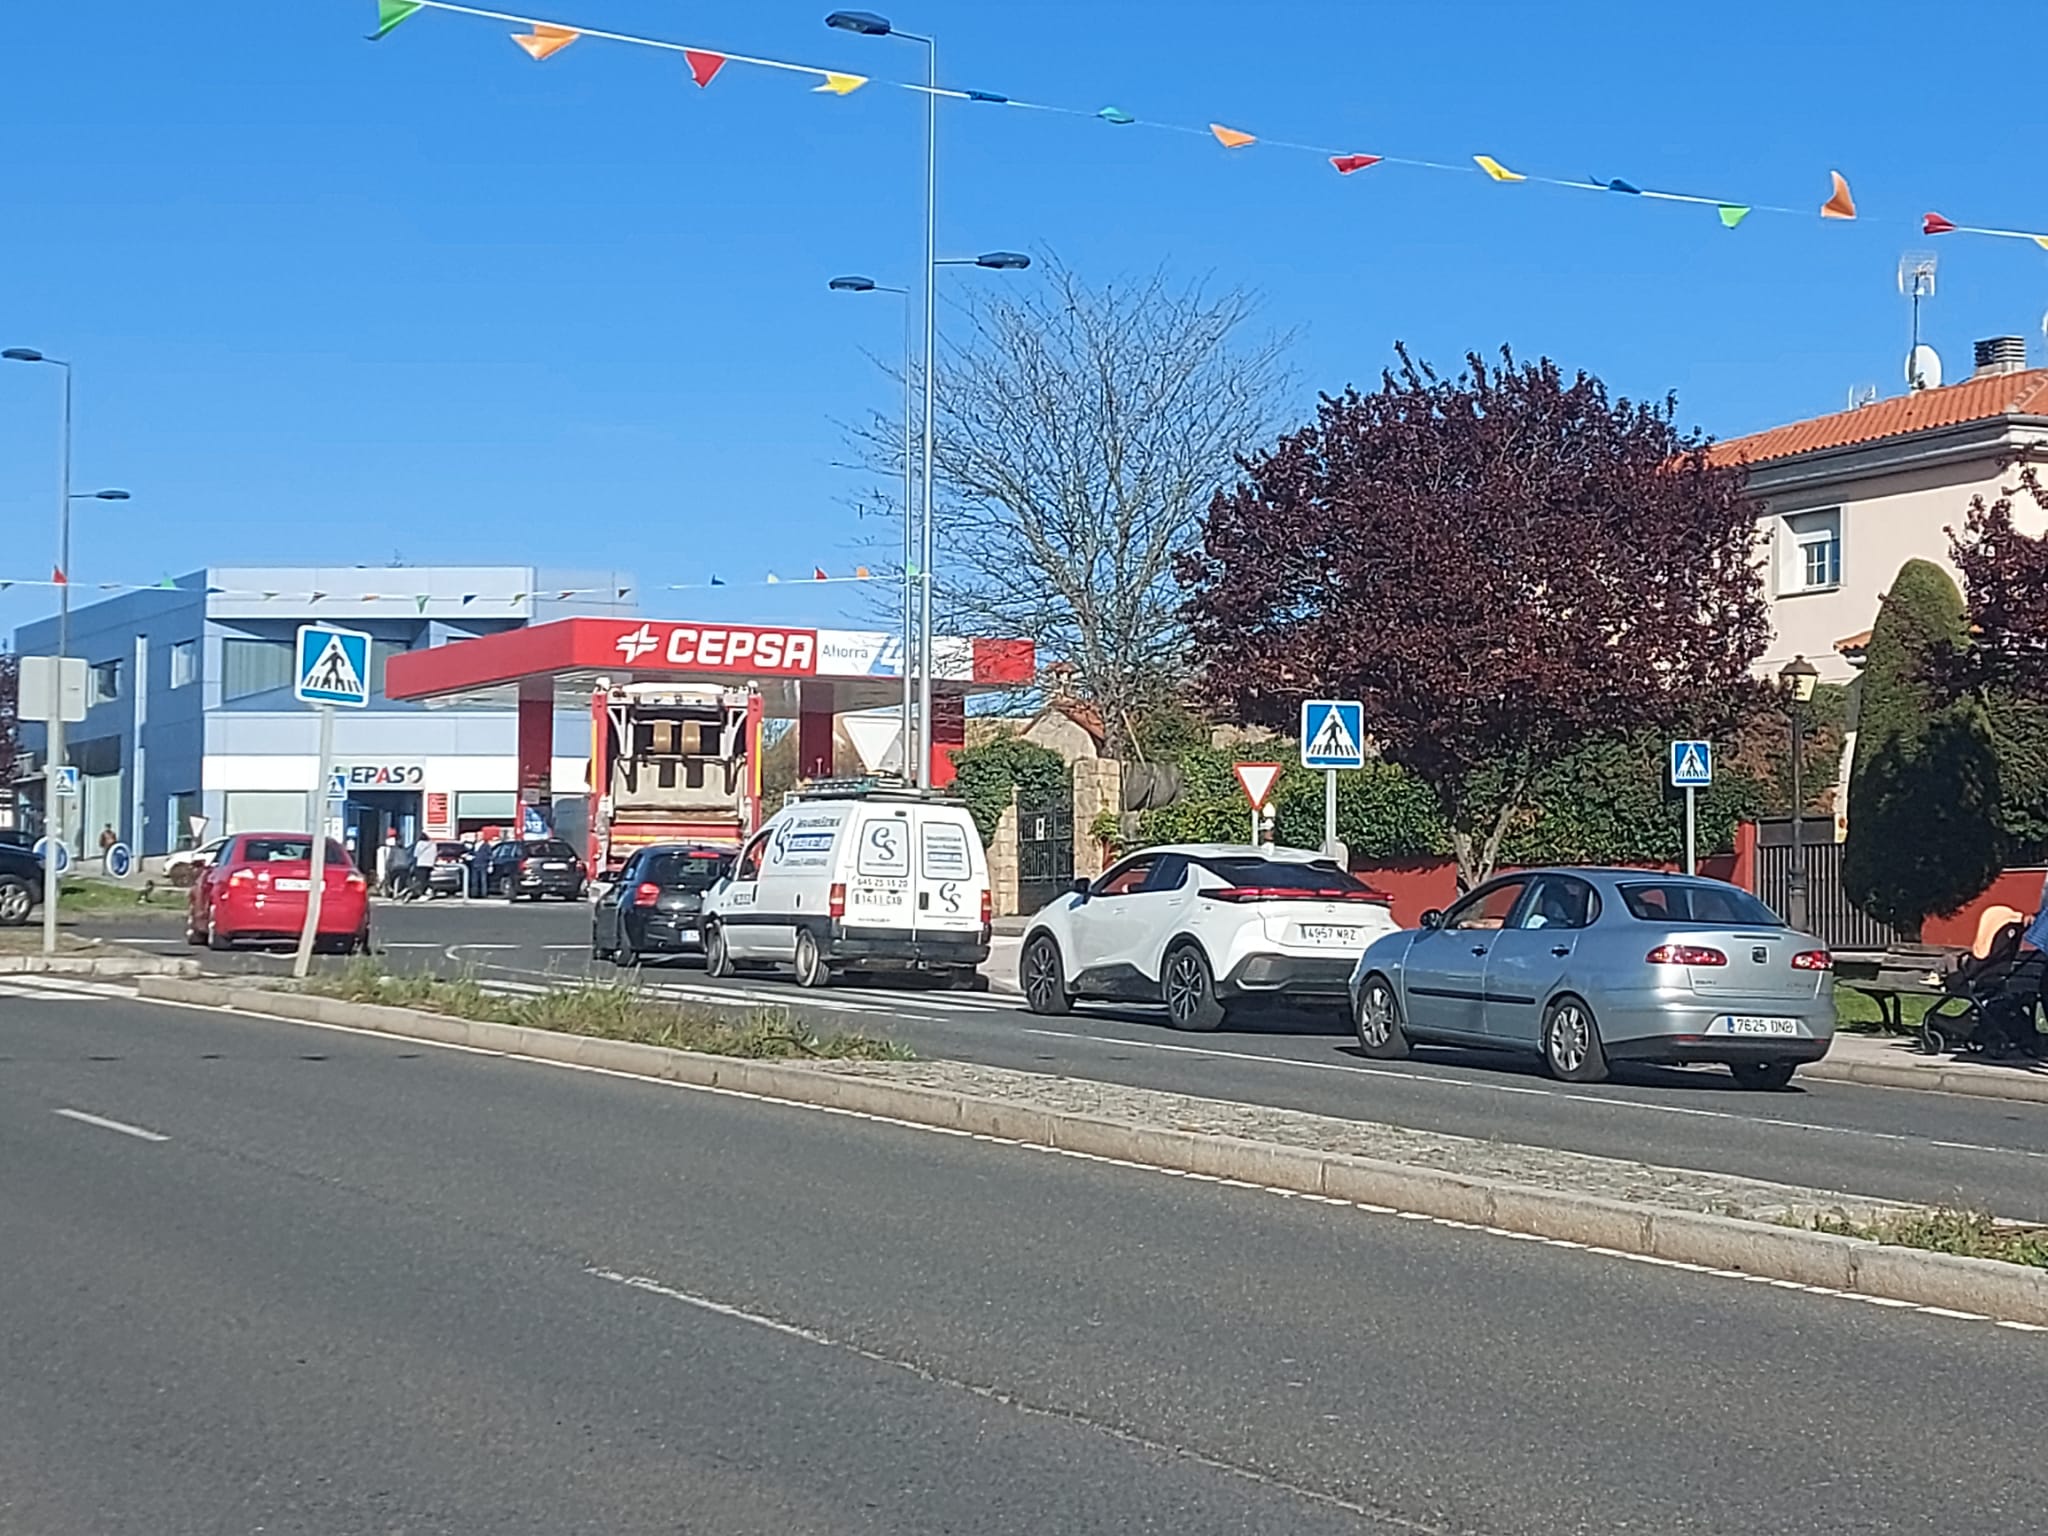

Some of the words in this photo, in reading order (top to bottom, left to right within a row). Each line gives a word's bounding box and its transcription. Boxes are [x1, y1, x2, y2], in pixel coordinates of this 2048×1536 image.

[666, 628, 814, 669] CEPSA
[822, 644, 869, 660] Ahorra
[1737, 1018, 1768, 1033] 7625
